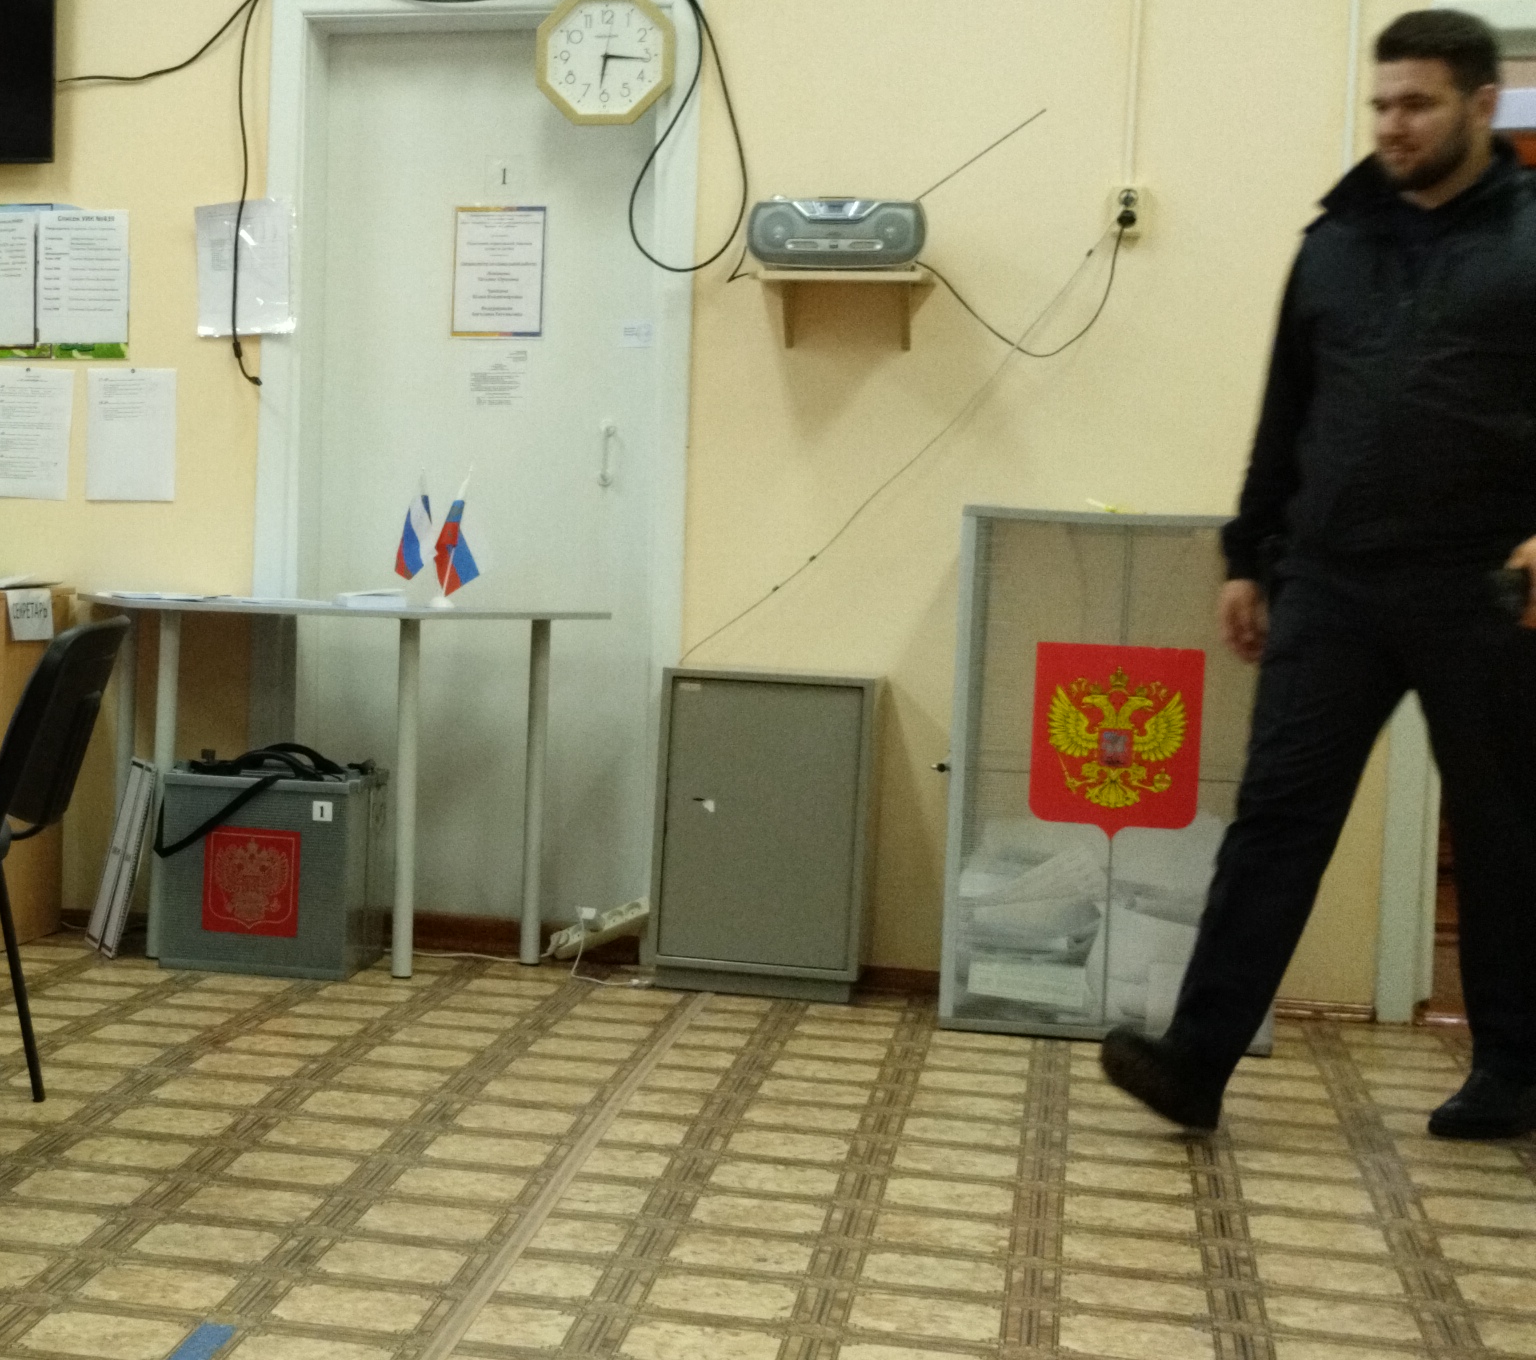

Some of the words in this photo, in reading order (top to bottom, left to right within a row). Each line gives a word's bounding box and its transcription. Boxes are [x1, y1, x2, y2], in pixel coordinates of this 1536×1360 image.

[600, 9, 615, 25] 12
[565, 29, 584, 45] 10
[636, 27, 648, 43] 2
[11, 601, 49, 620] СЕКРЕТАРЬ
